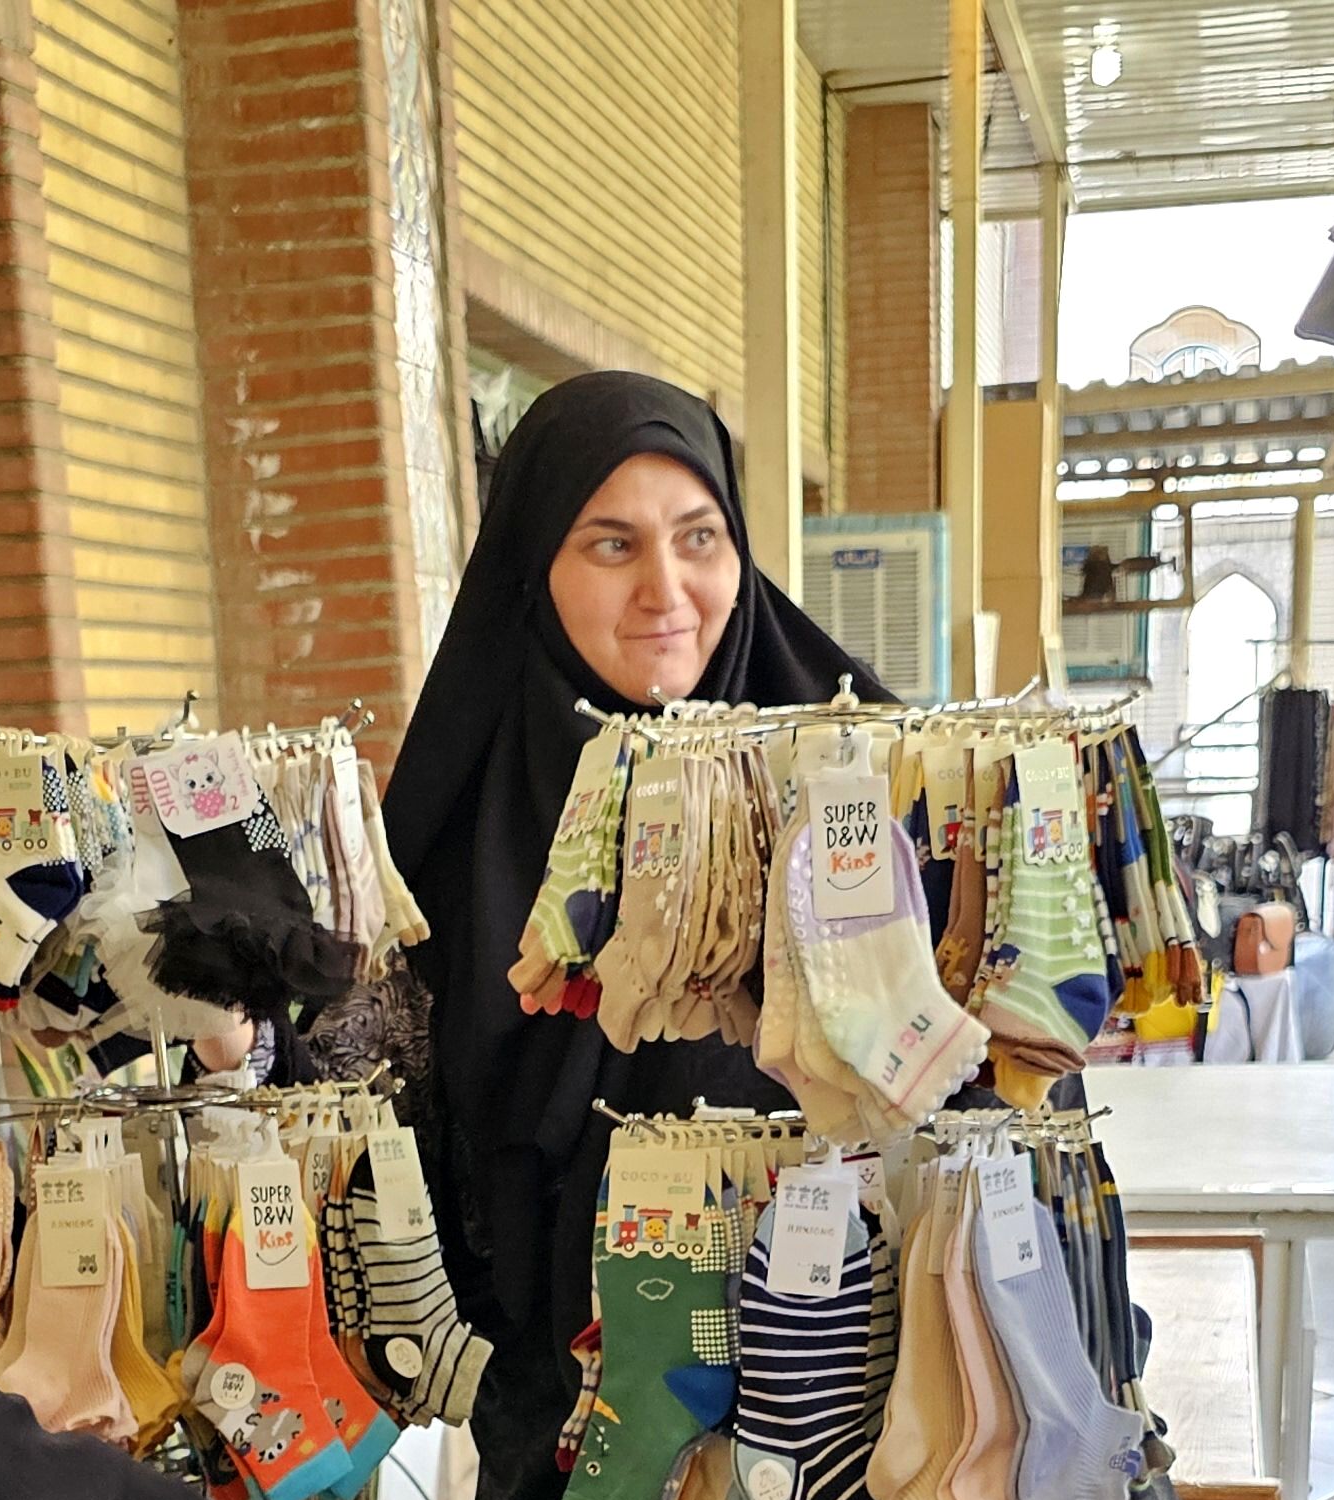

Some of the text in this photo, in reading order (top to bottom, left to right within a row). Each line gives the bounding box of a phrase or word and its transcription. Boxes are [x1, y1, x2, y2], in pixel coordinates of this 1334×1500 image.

[823, 801, 876, 825] SUPER
[826, 823, 879, 850] D&W
[250, 1184, 292, 1204] SUPER
[253, 1205, 294, 1227] D&W
